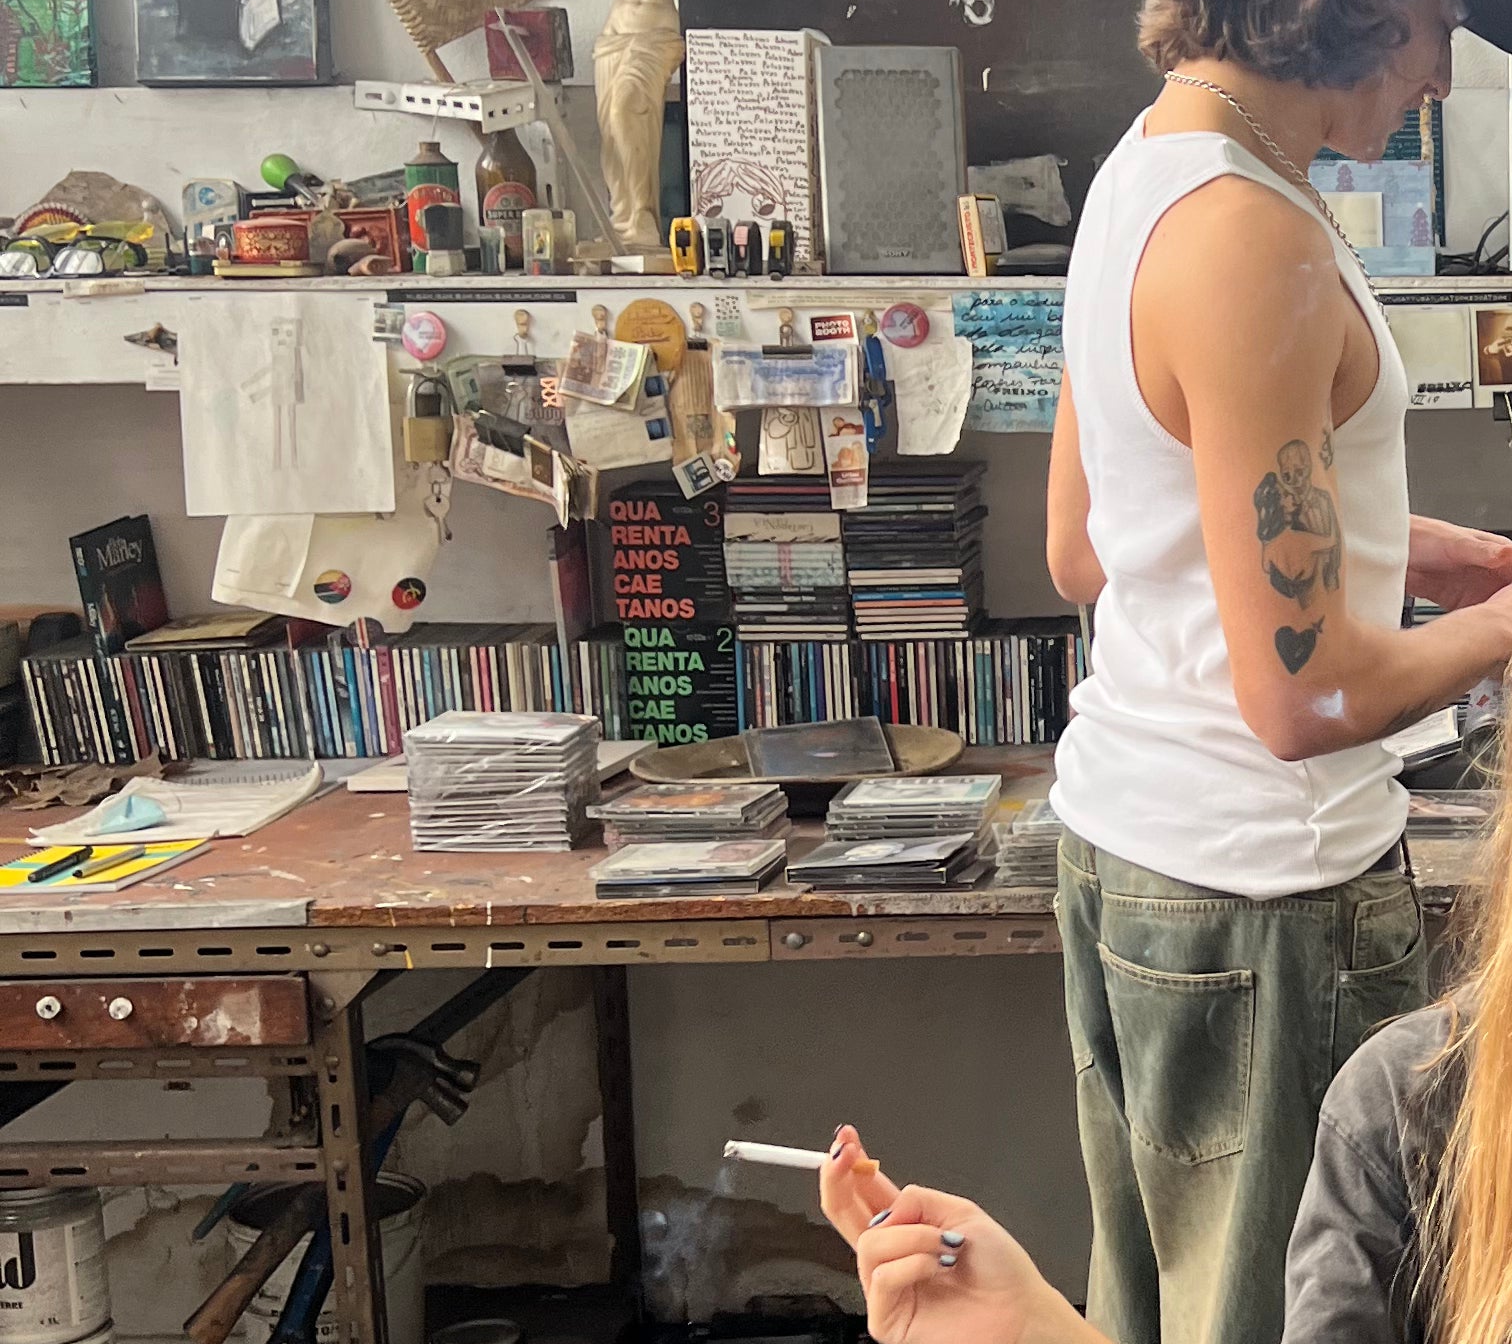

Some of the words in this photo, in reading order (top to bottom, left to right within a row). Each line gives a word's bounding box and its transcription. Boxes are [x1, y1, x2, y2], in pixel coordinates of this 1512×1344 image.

[814, 319, 850, 329] PHOTO
[815, 327, 851, 337] BOOTH
[610, 500, 662, 522] QUA
[703, 501, 720, 527] 3
[610, 525, 692, 546] RENTA
[613, 549, 680, 571] ANOS
[614, 574, 663, 594] CAE
[615, 598, 696, 619] TANOS
[624, 627, 677, 648] QUA
[716, 627, 734, 652] 2
[625, 651, 705, 672] RENTA
[628, 675, 693, 696] ANOS
[628, 699, 677, 720] CAE
[630, 723, 709, 744] TANOS
